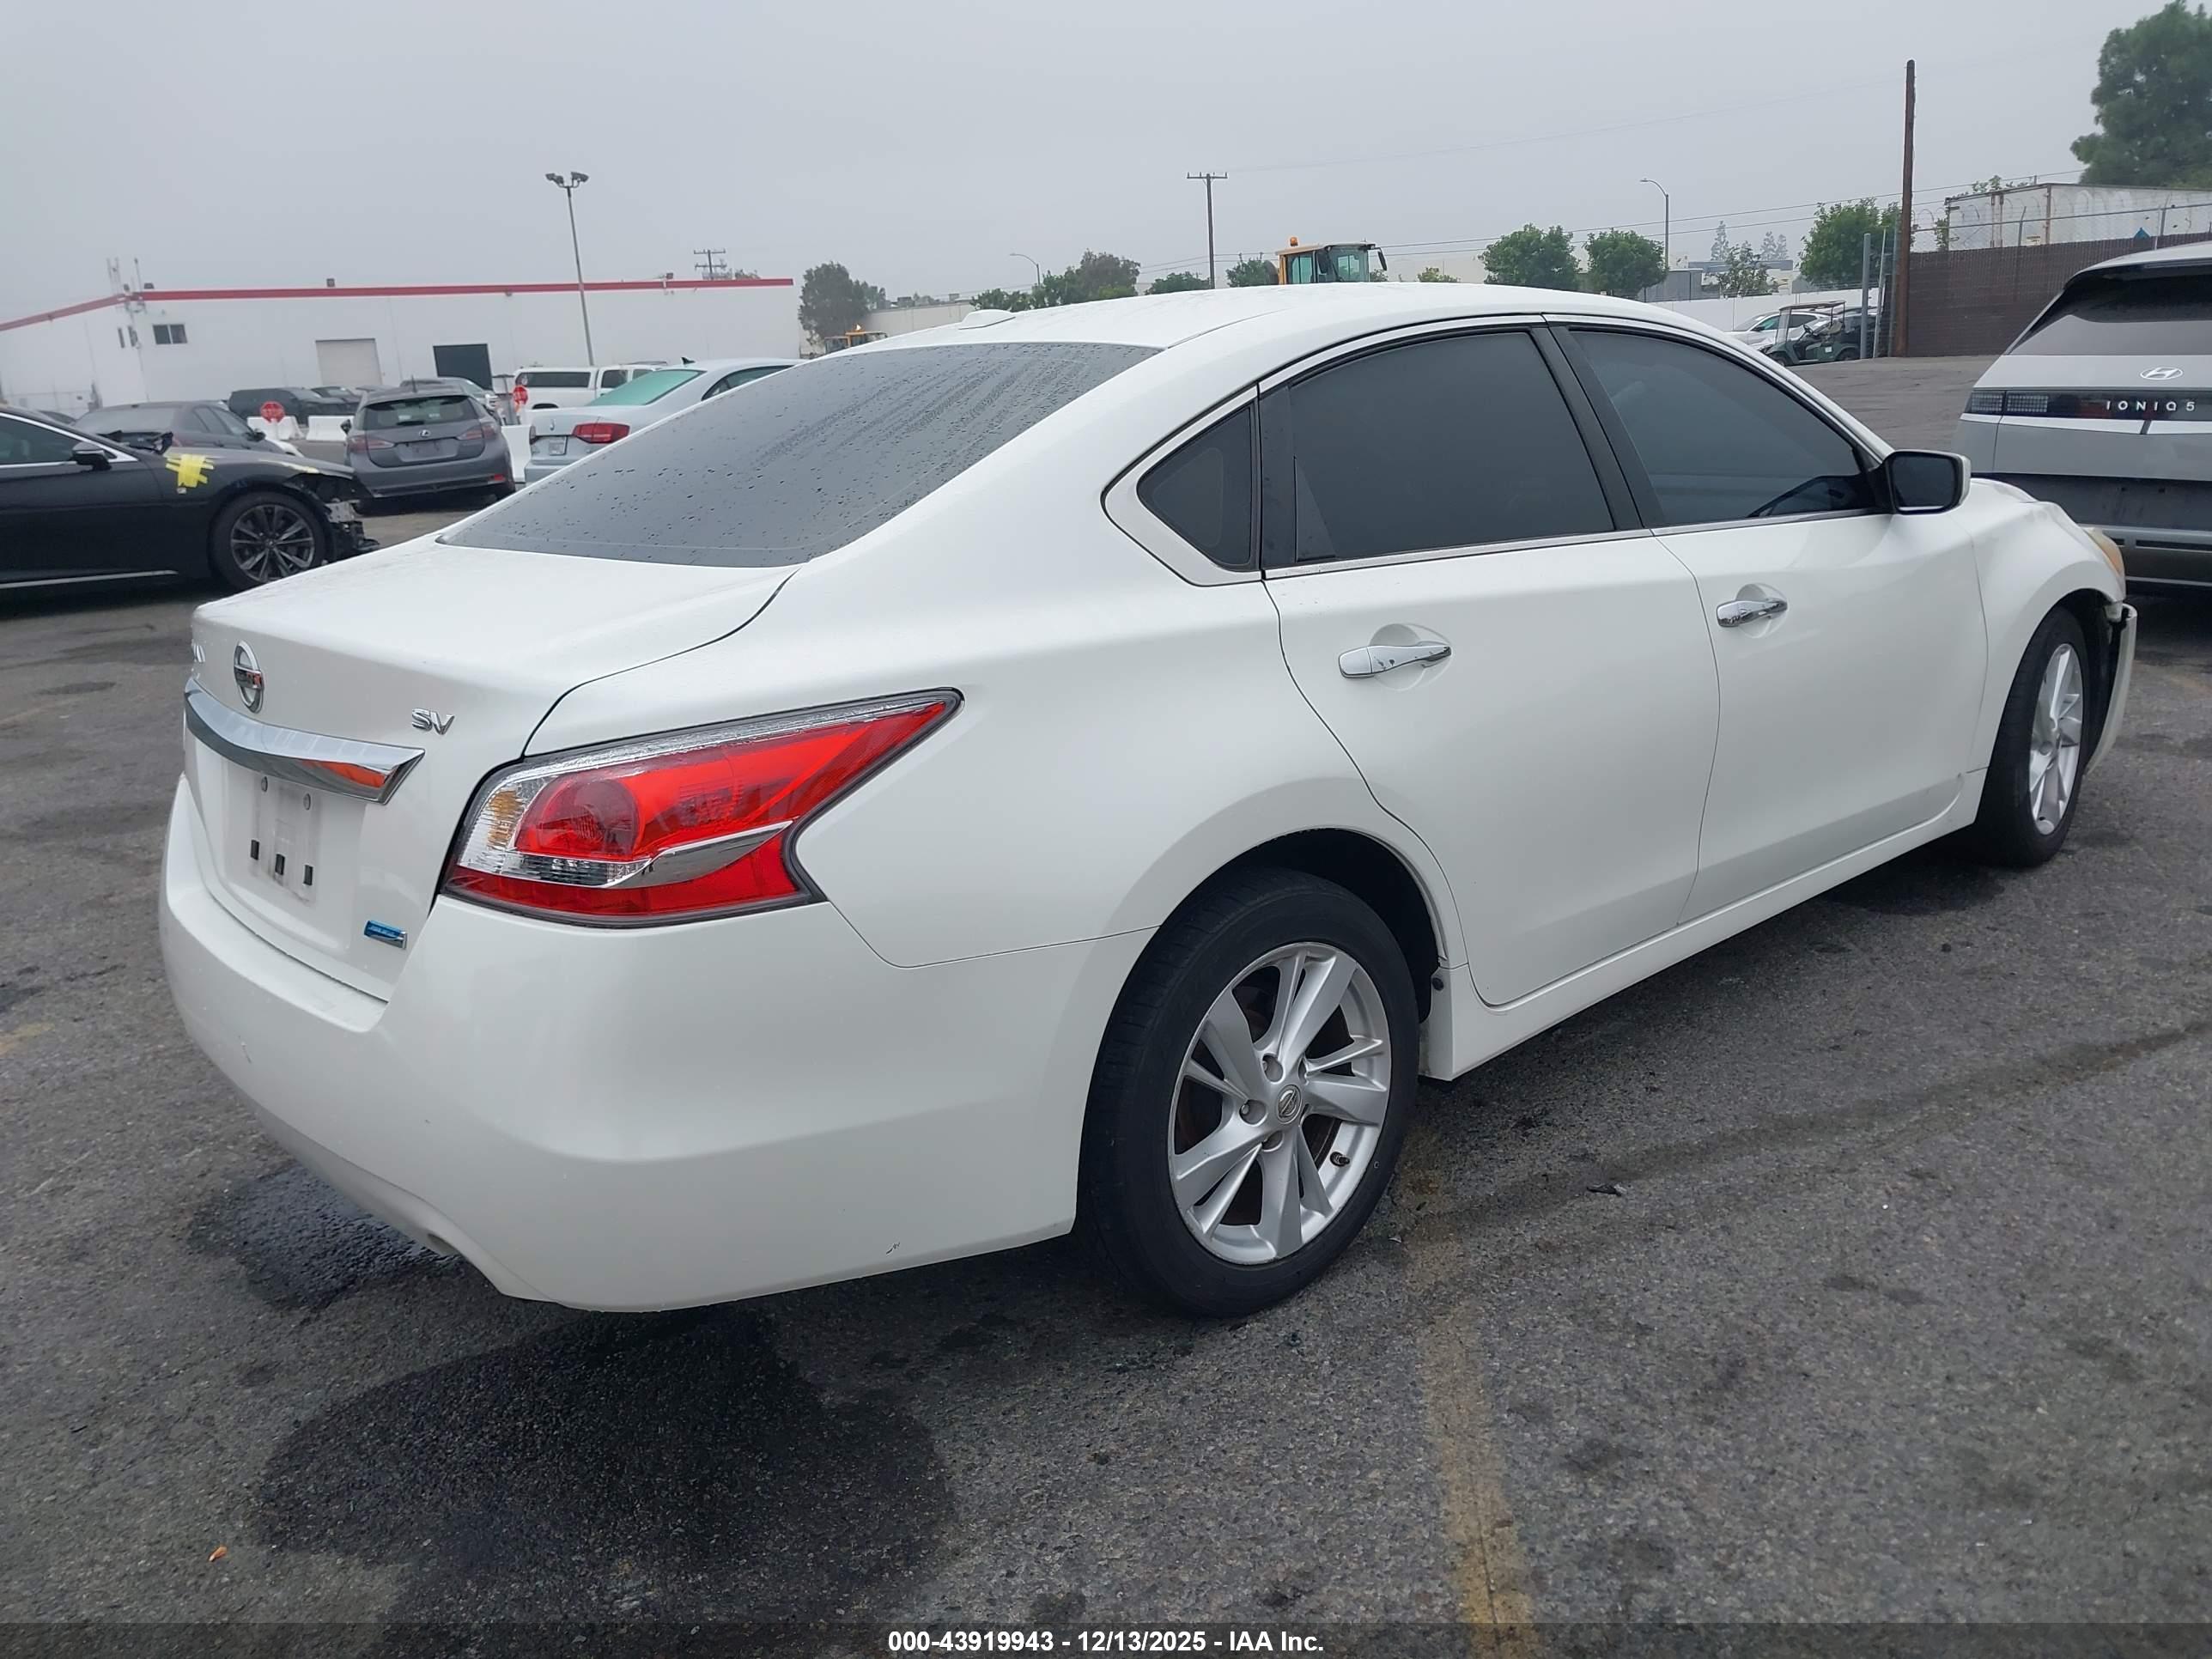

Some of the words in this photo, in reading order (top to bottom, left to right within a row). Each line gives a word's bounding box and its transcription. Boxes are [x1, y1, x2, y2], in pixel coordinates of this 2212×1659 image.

[2106, 400, 2177, 411] IONIQ
[2185, 401, 2196, 411] 5
[411, 708, 455, 735] SV
